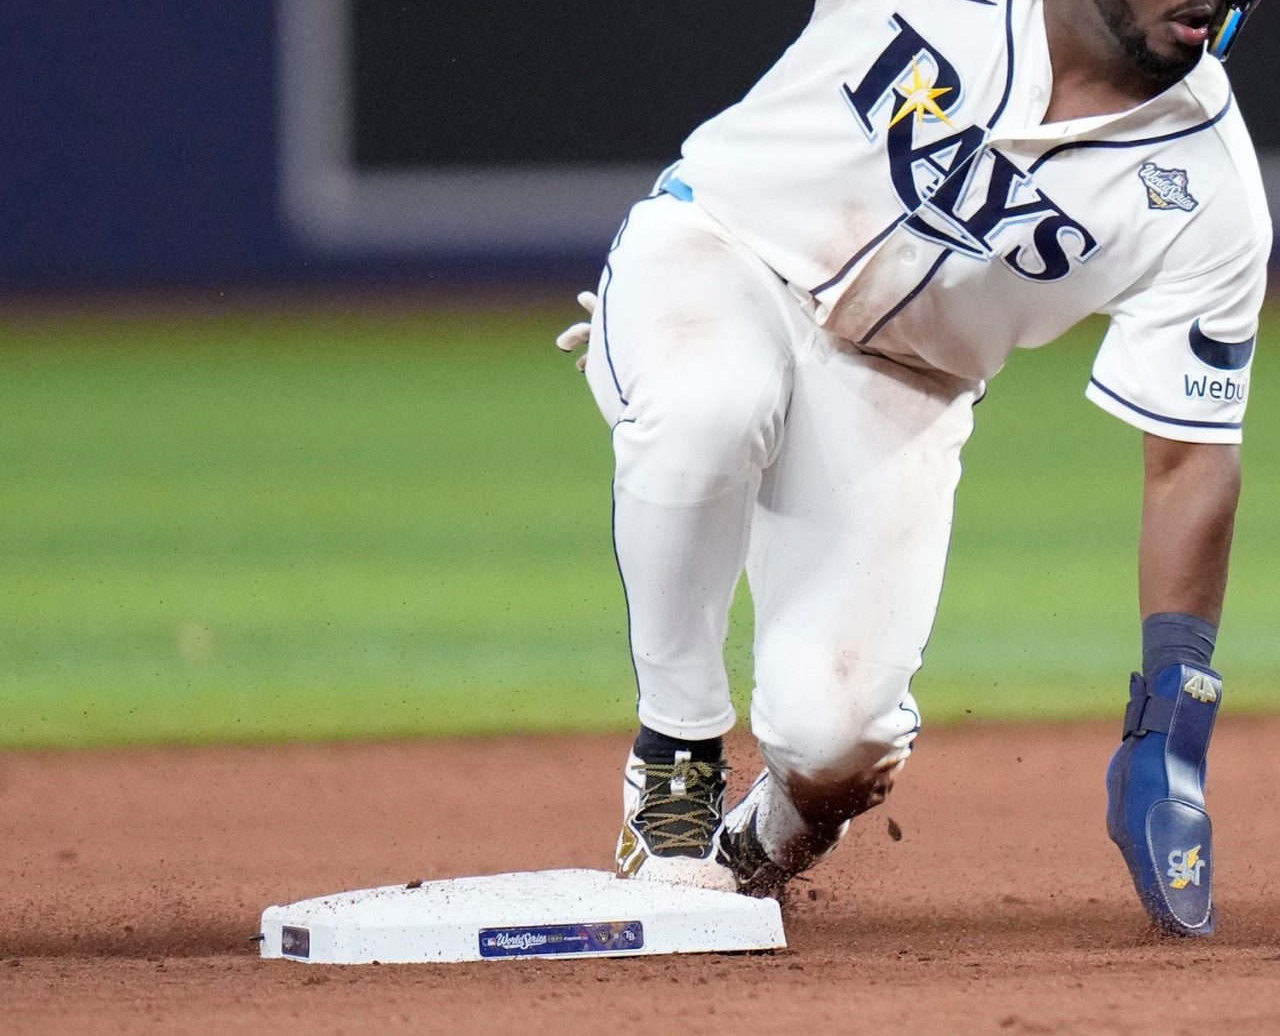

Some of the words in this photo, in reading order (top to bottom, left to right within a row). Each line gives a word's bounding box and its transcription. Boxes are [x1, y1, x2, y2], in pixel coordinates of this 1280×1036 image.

[840, 11, 1101, 282] RAYS
[1140, 164, 1172, 193] World
[1160, 185, 1197, 211] Series
[496, 933, 525, 947] World
[520, 933, 547, 950] Series
